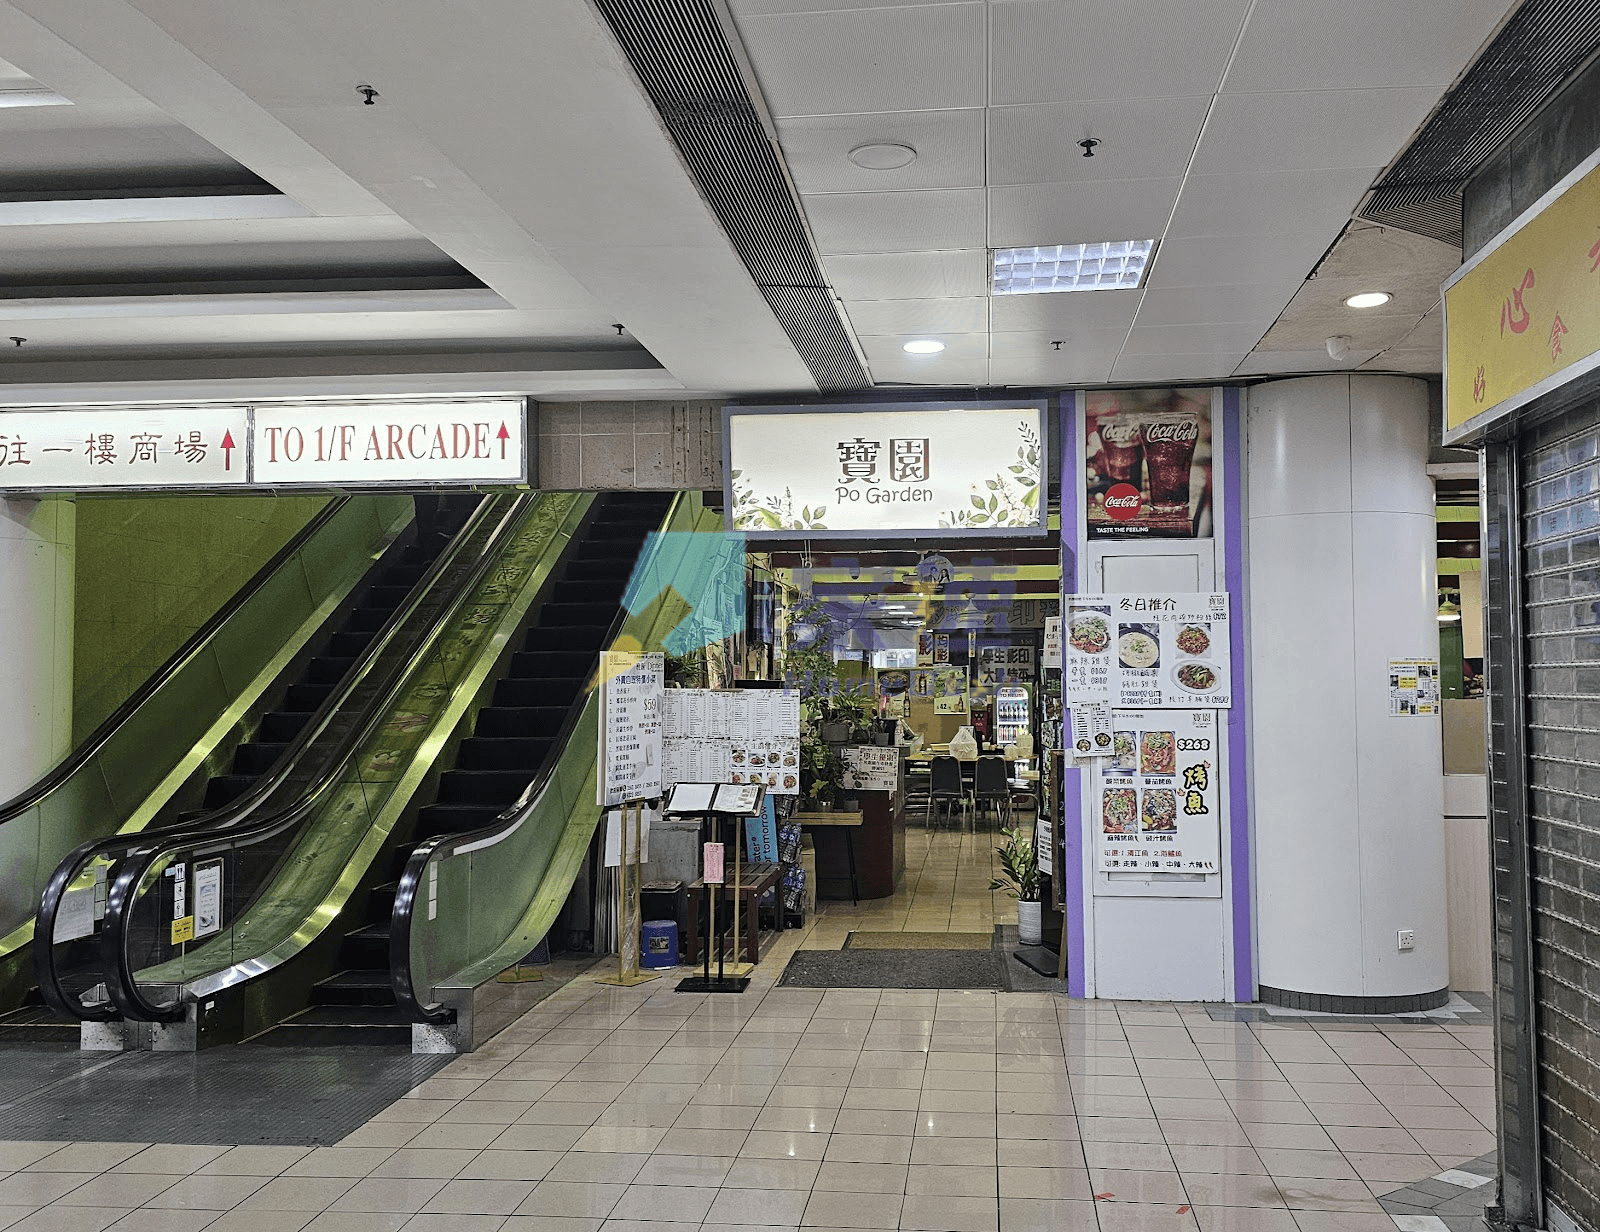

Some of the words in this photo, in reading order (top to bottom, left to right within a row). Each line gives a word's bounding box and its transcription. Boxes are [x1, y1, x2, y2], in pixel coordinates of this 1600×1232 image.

[264, 425, 304, 463] TO
[314, 424, 356, 462] 1/F
[363, 421, 492, 461] ARCADE
[836, 437, 930, 484] 寶園
[834, 487, 860, 505] Po
[865, 486, 933, 504] Garden
[1105, 495, 1141, 508] Coca-Cola
[1119, 597, 1177, 611] 冬日推介
[644, 698, 656, 711] $59
[1177, 738, 1210, 751] $268
[1182, 764, 1209, 815] 烤魚
[761, 806, 771, 854] tomorrow
